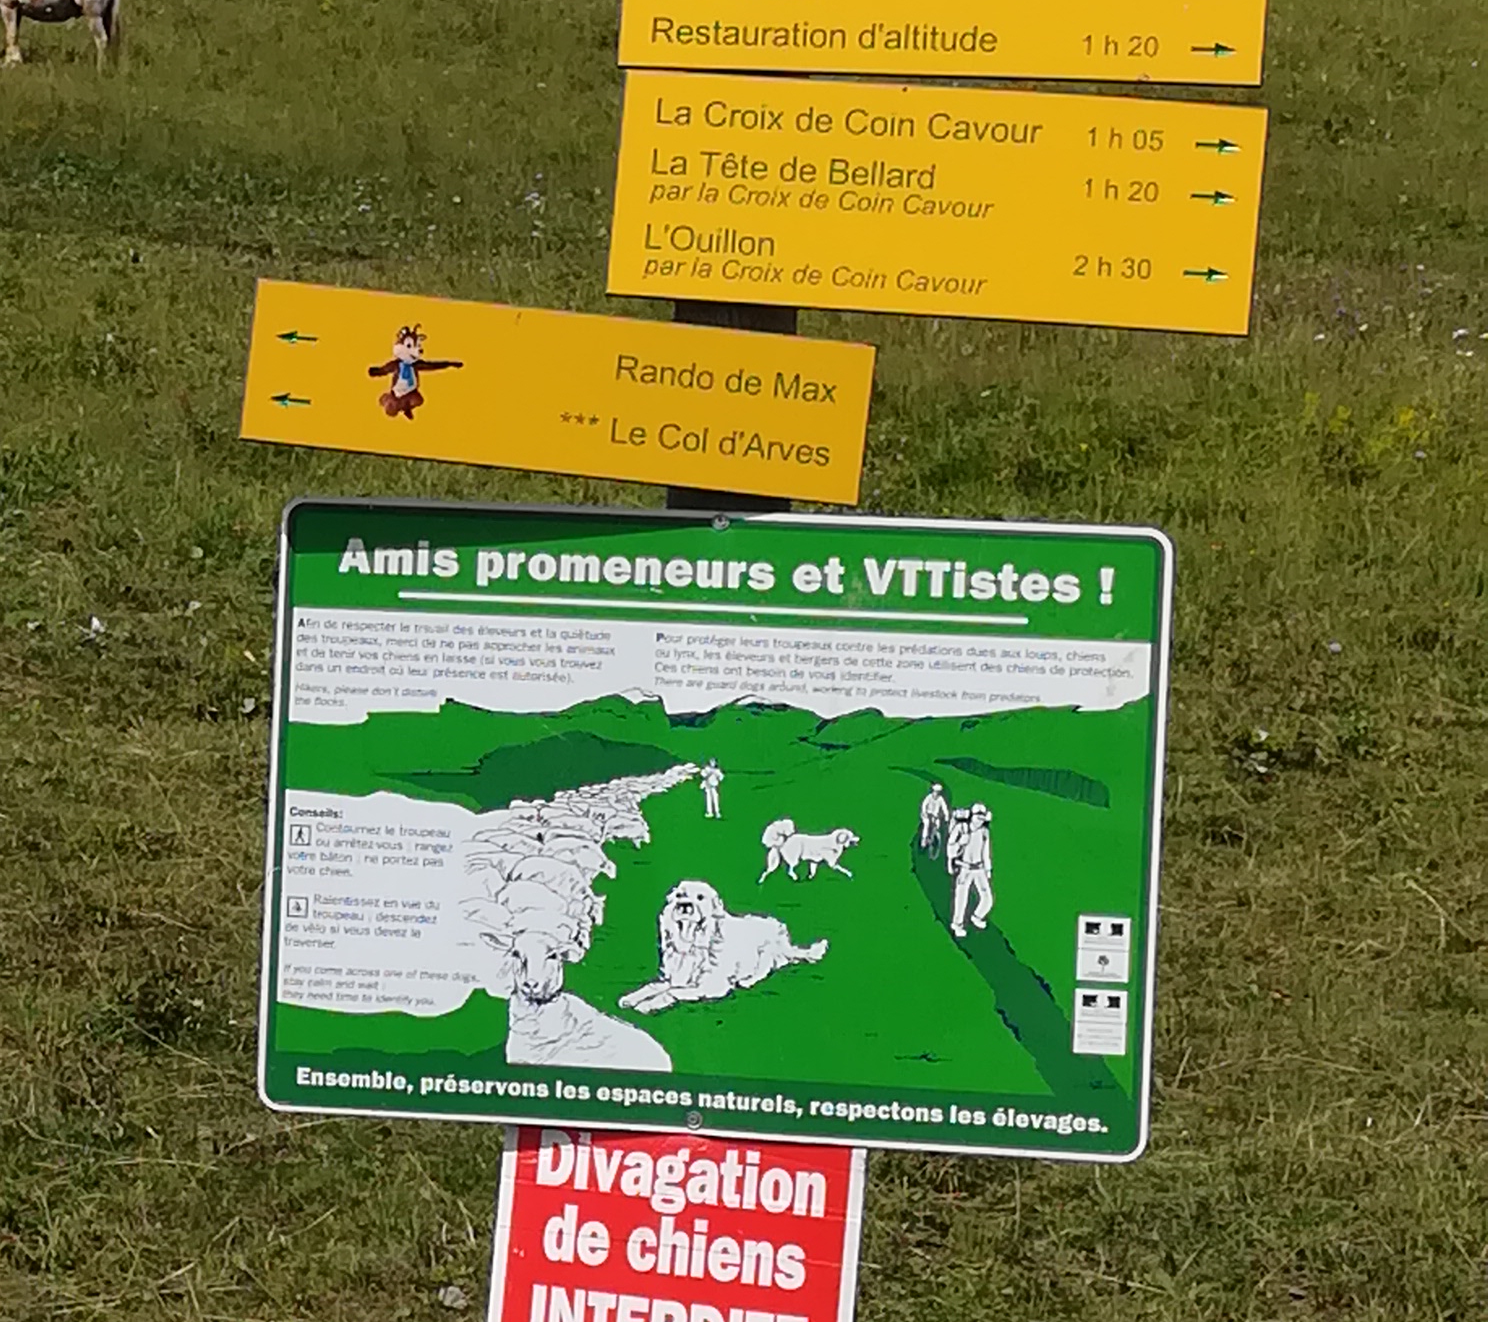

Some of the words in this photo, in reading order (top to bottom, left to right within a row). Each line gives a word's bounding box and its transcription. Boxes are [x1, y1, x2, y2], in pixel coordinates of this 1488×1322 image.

[652, 17, 845, 49] Restauration
[858, 23, 997, 52] d'altitude
[1083, 35, 1091, 55] 1
[1105, 35, 1118, 55] h
[1128, 36, 1158, 58] 20
[657, 98, 691, 125] La
[705, 101, 783, 130] Croix
[796, 107, 832, 133] de
[845, 109, 914, 137] Coin
[928, 113, 1043, 143] Cavour
[1089, 127, 1096, 146] 1
[1109, 127, 1122, 149] h
[1133, 130, 1164, 151] 05
[652, 148, 687, 175] La
[700, 151, 767, 180] Tête
[780, 156, 816, 183] de
[829, 159, 936, 189] Bellard
[649, 185, 693, 203] par
[697, 182, 719, 203] la
[729, 184, 791, 207] Croix
[799, 189, 829, 209] de
[839, 191, 894, 213] Coin
[904, 194, 994, 218] Cavour
[1086, 178, 1092, 197] 1
[1105, 179, 1118, 200] h
[1128, 181, 1159, 202] 20
[645, 224, 774, 256] L'Ouillon
[643, 260, 686, 279] par
[691, 257, 712, 278] la
[722, 260, 784, 282] Croix
[793, 264, 822, 285] de
[832, 266, 887, 289] Coin
[897, 269, 987, 294] Cavour
[1073, 255, 1088, 276] 2
[1098, 257, 1111, 276] h
[1121, 257, 1151, 279] 30
[616, 355, 714, 390] Rando
[725, 369, 761, 395] de
[774, 372, 836, 403] Max
[611, 418, 646, 446] Le
[659, 424, 709, 453] Col
[719, 431, 829, 466] d'Arves
[339, 539, 459, 577] Amis
[477, 551, 775, 593] promeneurs
[793, 557, 845, 594] et
[864, 558, 1080, 603] VTTistes
[1100, 568, 1114, 604] !
[297, 1067, 413, 1094] Ensemble,
[421, 1074, 549, 1097] préservons
[556, 1080, 590, 1099] les
[597, 1087, 692, 1106] espaces
[699, 1092, 802, 1118] naturels,
[810, 1101, 943, 1122] respectons
[950, 1105, 986, 1125] les
[992, 1108, 1108, 1134] élevages.
[536, 1129, 826, 1218] Divagation
[543, 1204, 609, 1266] de
[627, 1216, 805, 1289] chiens
